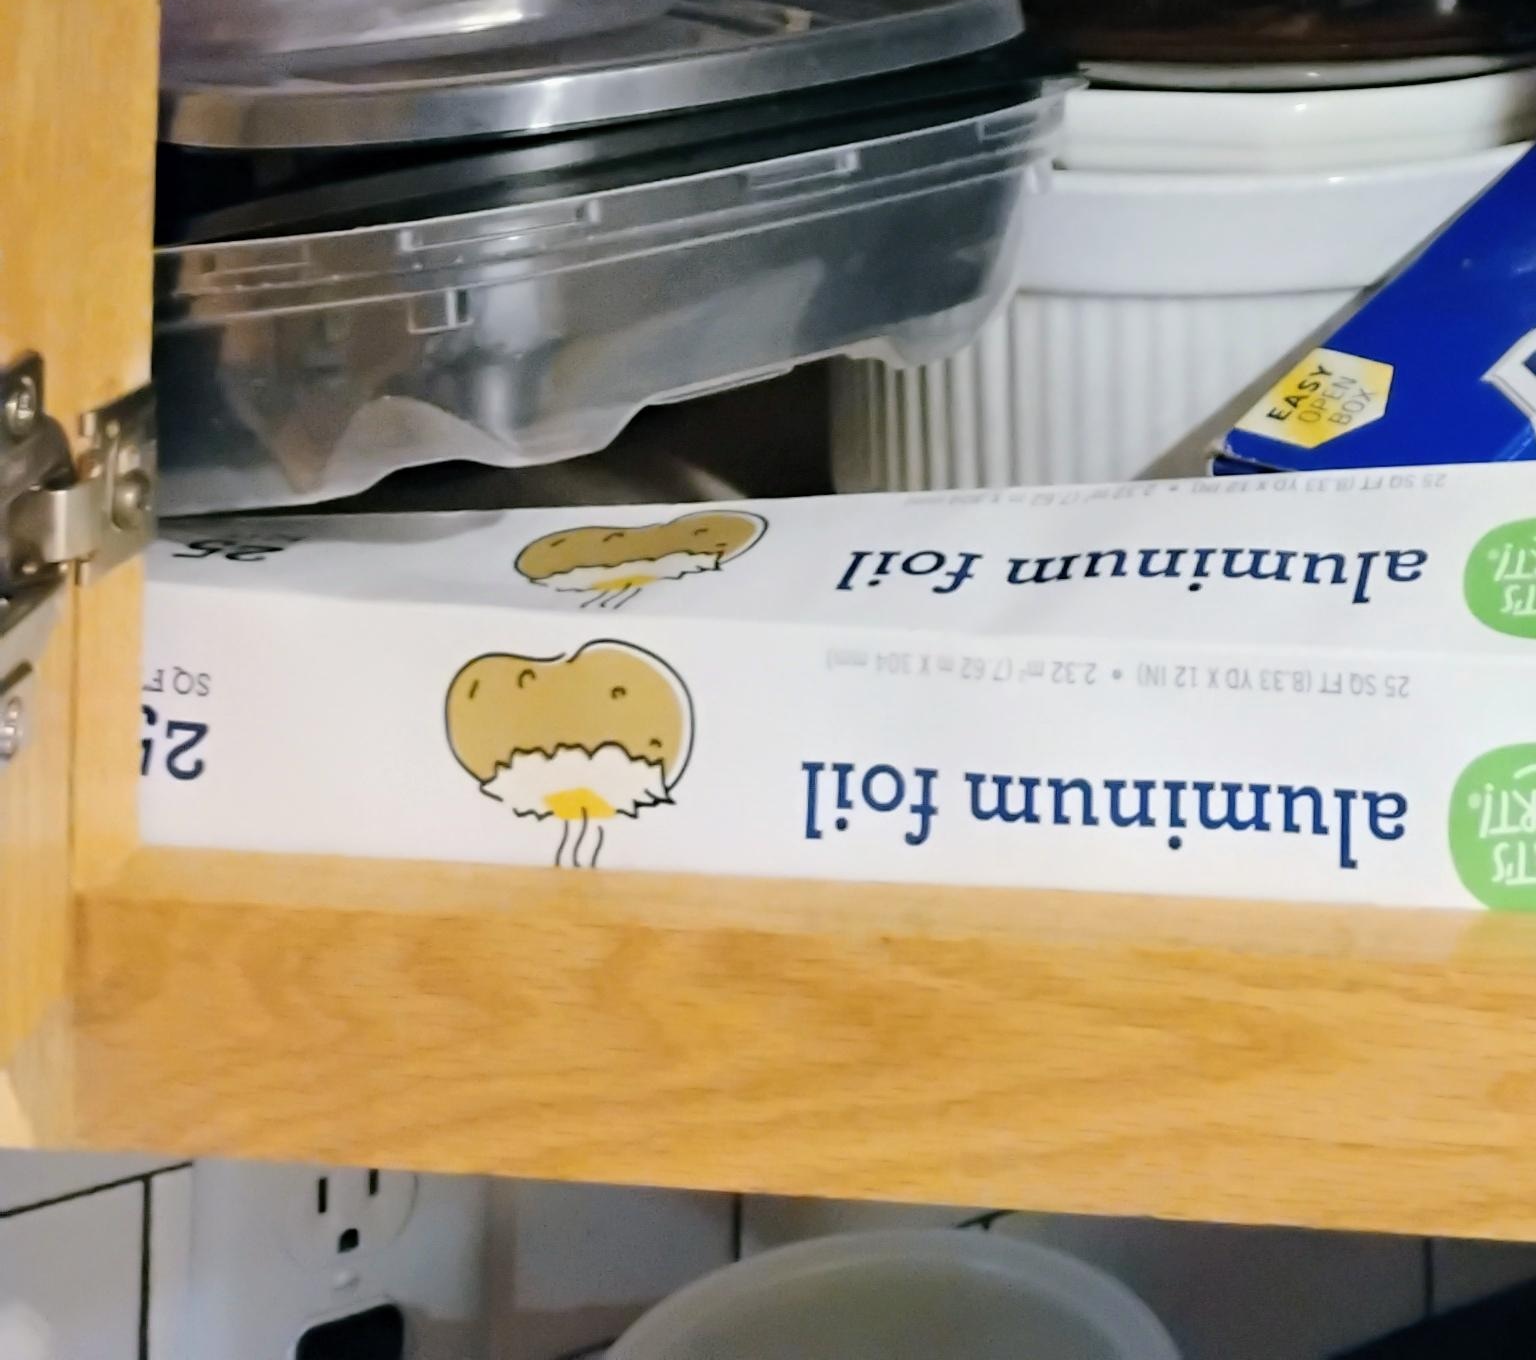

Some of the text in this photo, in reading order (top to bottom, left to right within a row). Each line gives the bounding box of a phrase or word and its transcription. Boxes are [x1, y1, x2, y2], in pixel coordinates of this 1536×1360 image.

[1266, 364, 1333, 422] EASY
[1297, 374, 1358, 425] OPEN
[1328, 387, 1377, 426] BOX
[172, 539, 284, 562] 25
[836, 547, 1429, 604] aluminum foil
[172, 666, 212, 697] SQ
[1051, 659, 1097, 686] 2.32
[1174, 665, 1198, 688] 12
[1225, 667, 1252, 691] YD
[1260, 668, 1312, 693] (8.33
[1317, 671, 1343, 695] FT
[1350, 672, 1377, 697] SQ
[1384, 674, 1410, 698] 25
[800, 760, 1409, 870] aluminum foil
